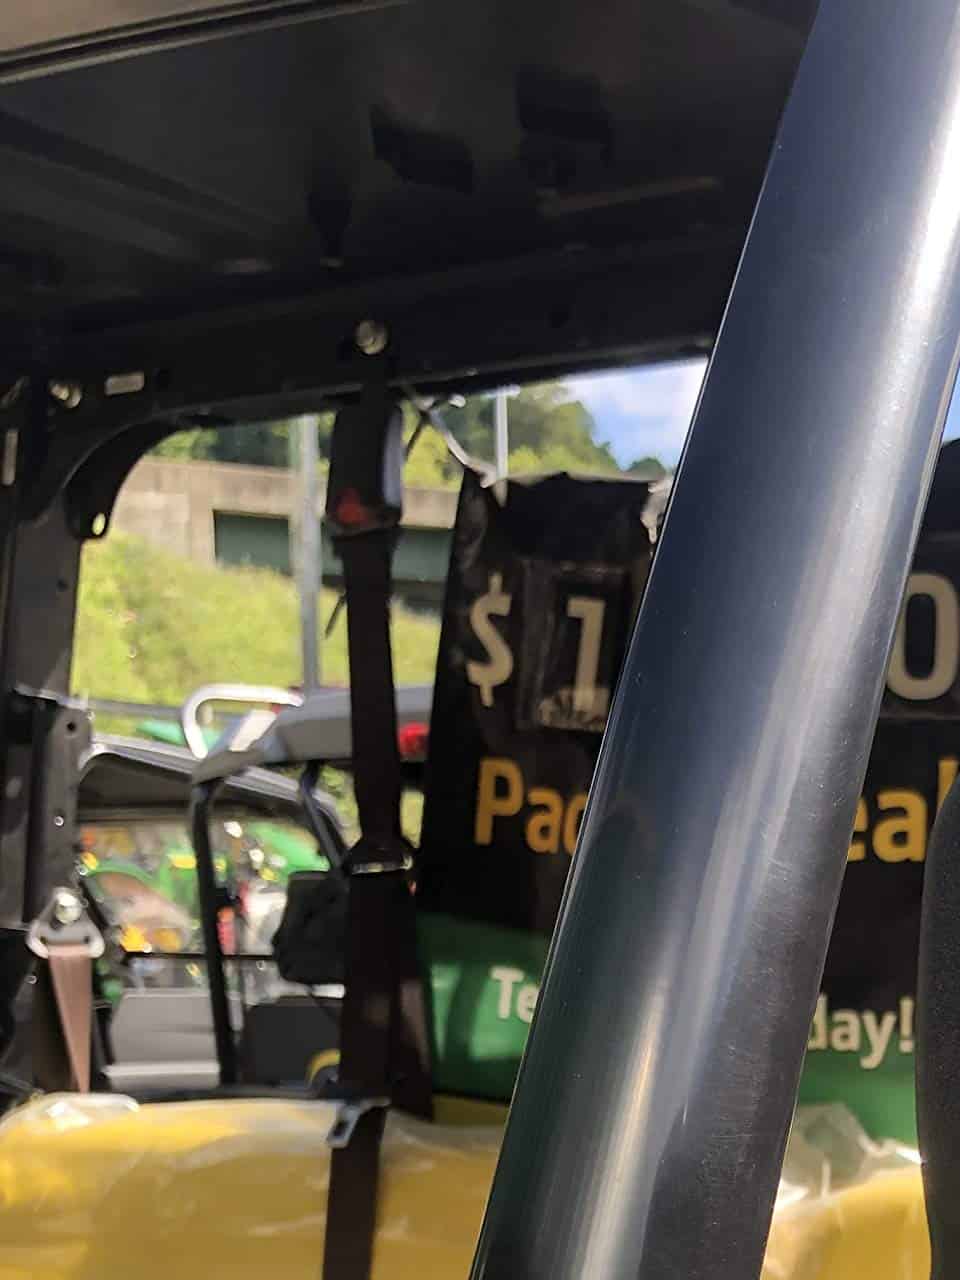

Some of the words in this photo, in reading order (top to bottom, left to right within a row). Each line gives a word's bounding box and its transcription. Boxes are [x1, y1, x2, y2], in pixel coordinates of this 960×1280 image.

[474, 756, 590, 854] Pac
[490, 966, 541, 1024] Te
[806, 992, 915, 1069] day!
